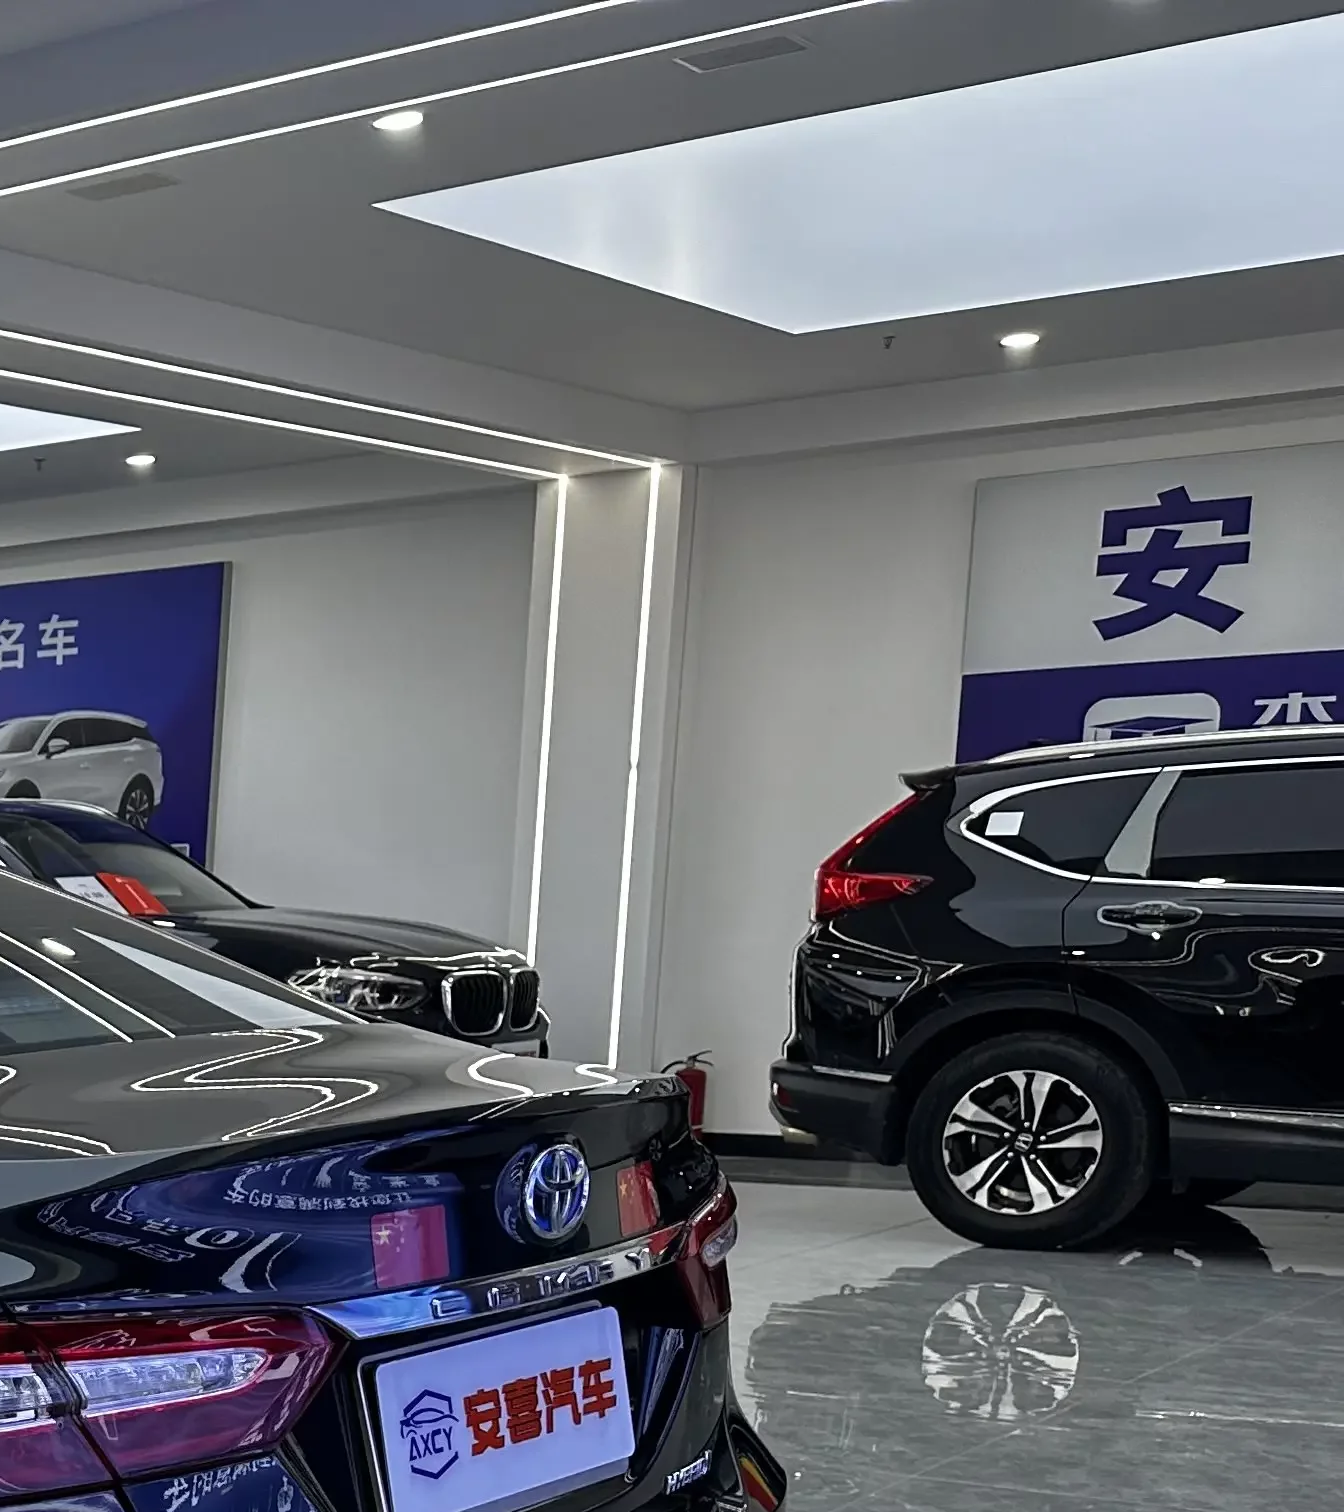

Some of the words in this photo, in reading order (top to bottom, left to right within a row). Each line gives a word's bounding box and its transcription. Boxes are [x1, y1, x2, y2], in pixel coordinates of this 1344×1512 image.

[1092, 485, 1253, 641] 安
[409, 1426, 453, 1462] AXCY
[463, 1357, 617, 1457] 安喜汽车
